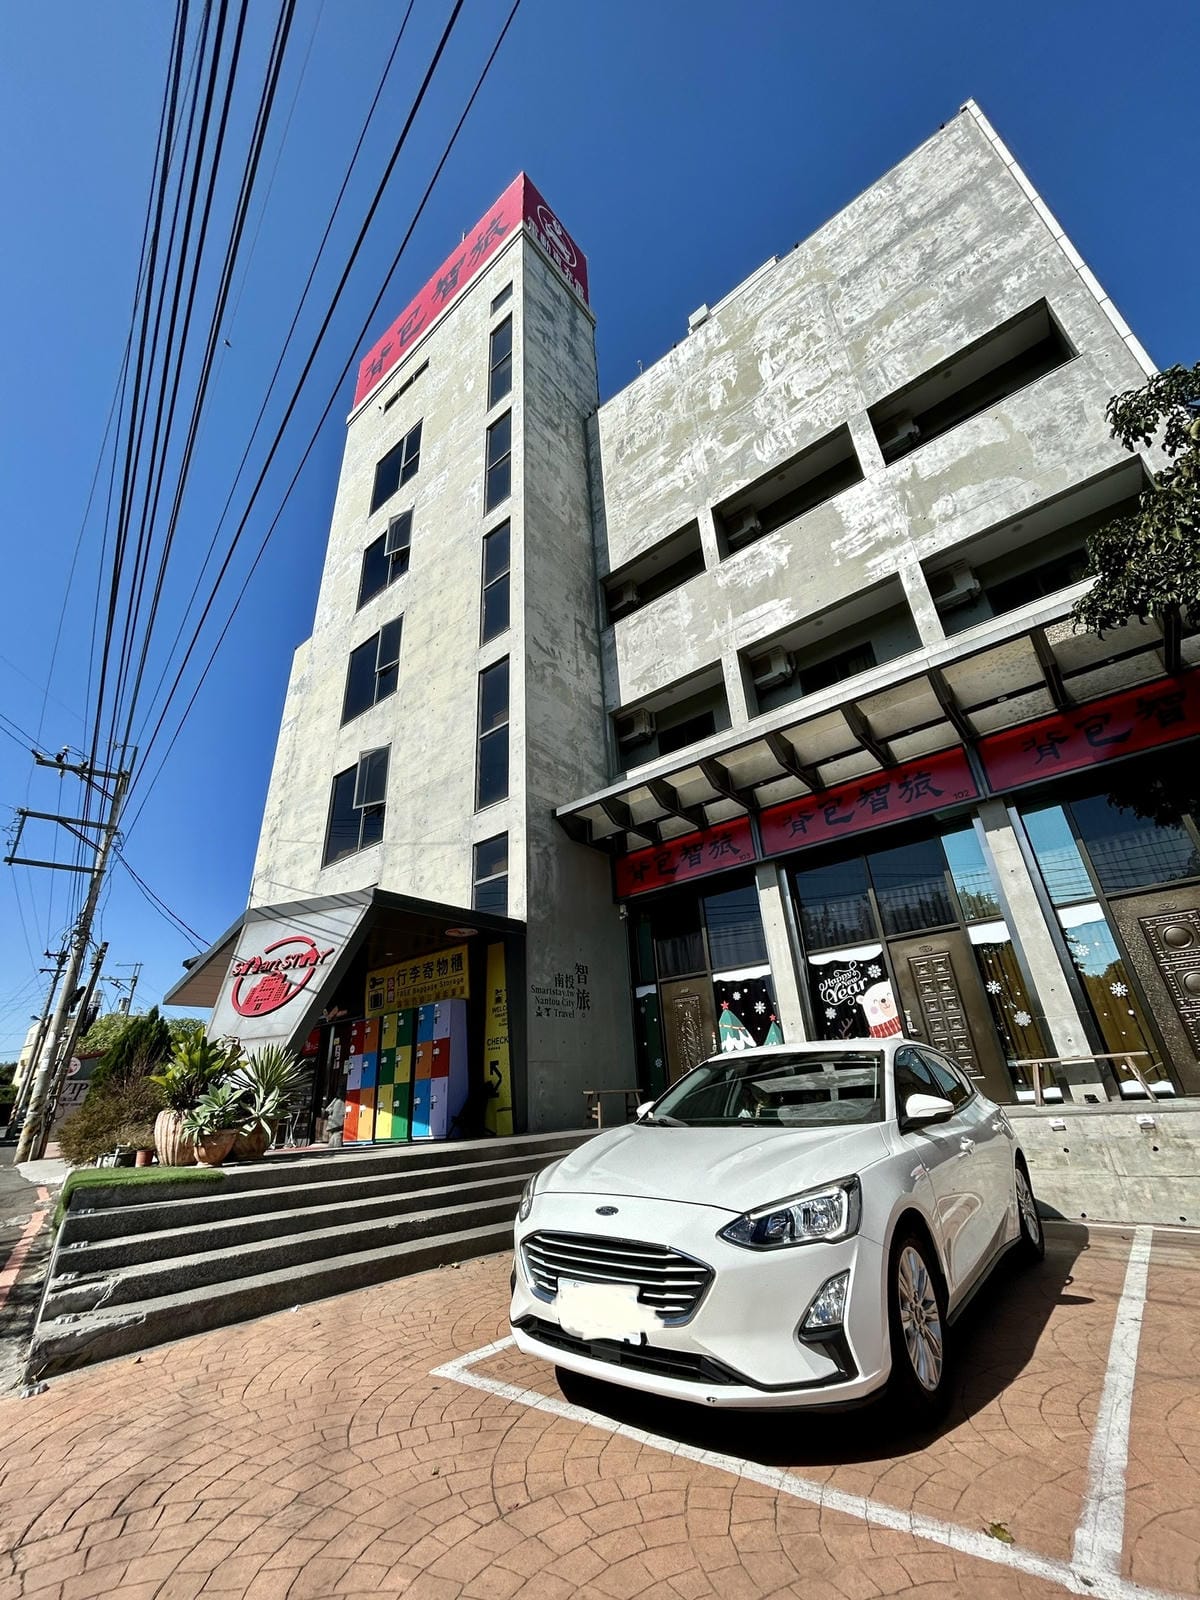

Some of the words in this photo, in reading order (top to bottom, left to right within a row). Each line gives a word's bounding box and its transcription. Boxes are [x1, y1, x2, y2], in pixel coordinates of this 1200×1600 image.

[953, 789, 970, 800] 102
[784, 770, 946, 838] 背包智旅
[627, 833, 741, 884] 背包智旅
[396, 952, 464, 987] 行李寄物櫃
[439, 977, 465, 988] Storage
[554, 973, 575, 989] 南投
[819, 971, 852, 991] Happy
[824, 977, 868, 1003] Year
[561, 996, 575, 1008] City
[553, 1008, 575, 1018] Travel
